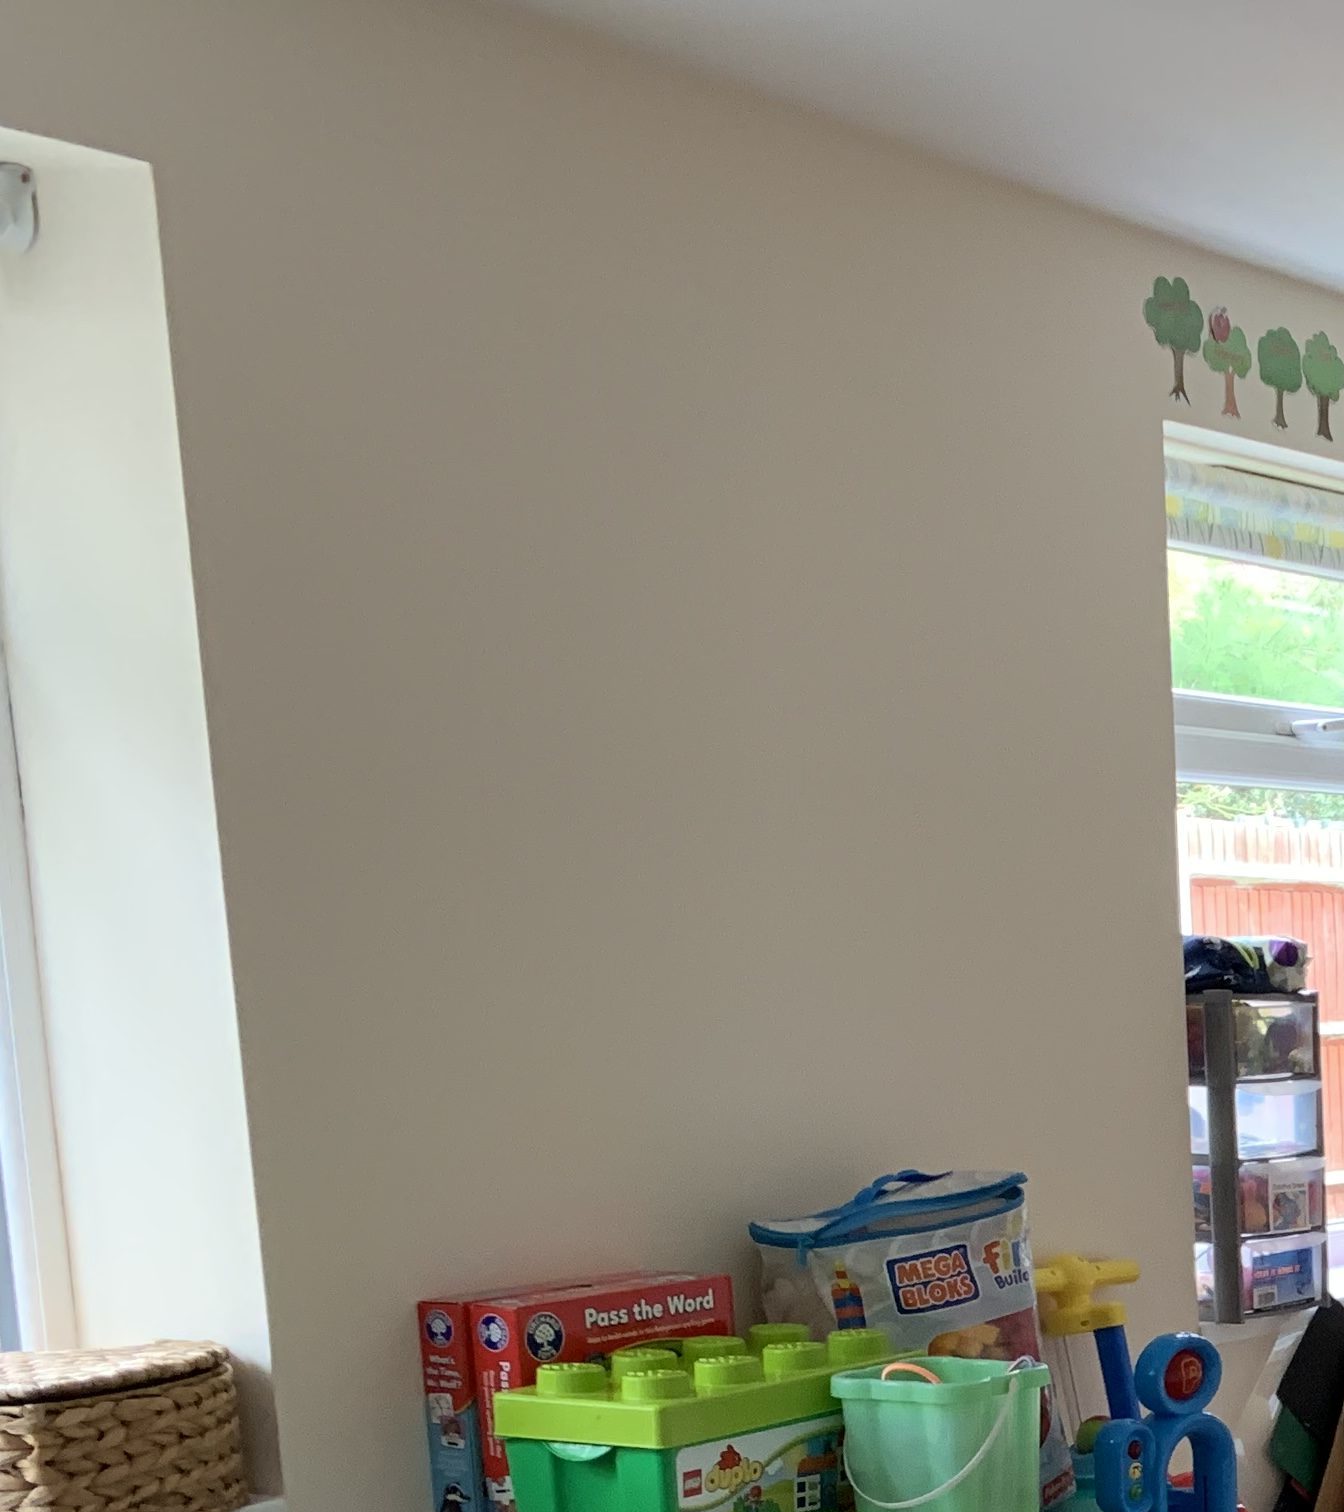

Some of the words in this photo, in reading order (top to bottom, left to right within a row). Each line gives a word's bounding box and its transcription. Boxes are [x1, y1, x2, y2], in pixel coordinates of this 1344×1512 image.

[895, 1250, 968, 1287] MEGA
[585, 1307, 630, 1329] Pass
[631, 1299, 664, 1322] the
[667, 1289, 715, 1317] Word
[899, 1274, 976, 1310] BLOKS
[704, 1457, 764, 1493] duplo
